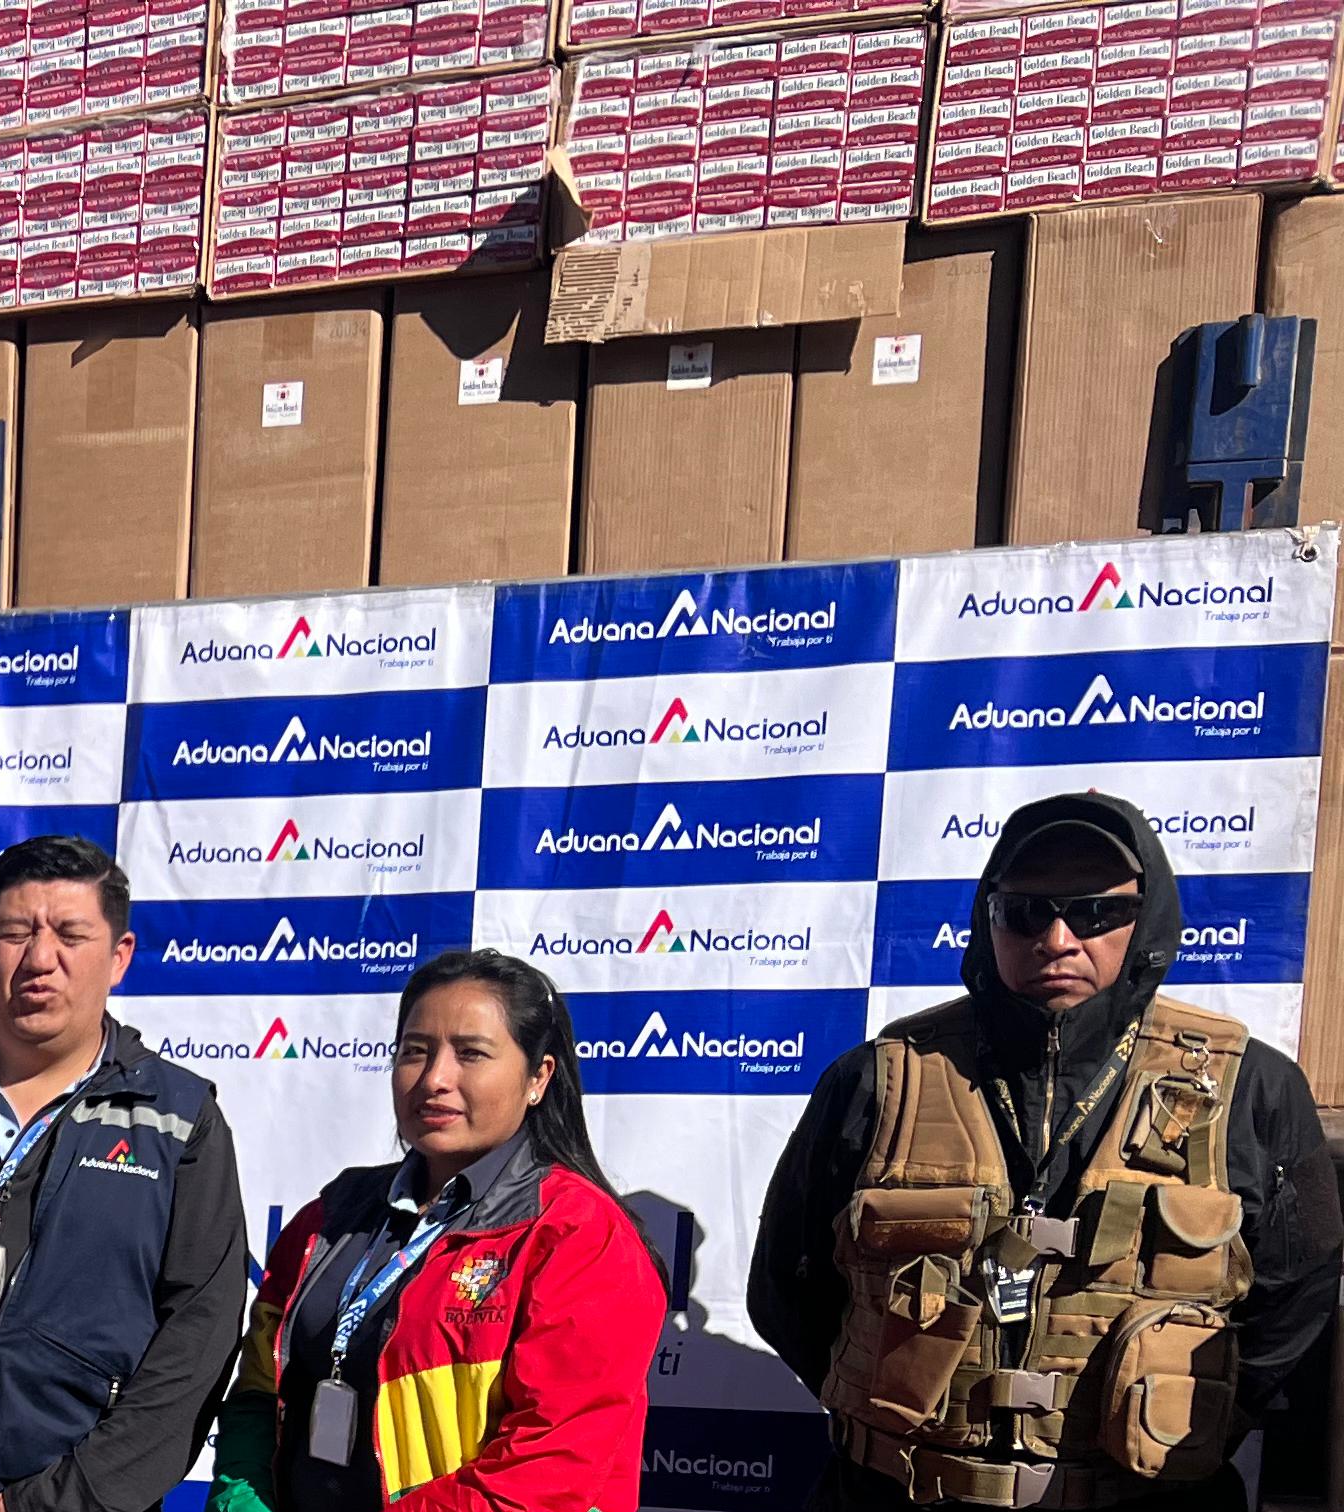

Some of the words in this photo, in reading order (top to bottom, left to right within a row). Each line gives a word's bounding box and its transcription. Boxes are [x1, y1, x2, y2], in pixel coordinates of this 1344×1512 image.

[855, 74, 886, 87] Golden
[892, 71, 920, 83] Beach
[934, 184, 967, 198] Golden
[970, 181, 1000, 194] Beach
[1010, 173, 1043, 186] Golden
[1047, 169, 1076, 183] Beach
[216, 262, 242, 274] Golden
[245, 259, 270, 271] Beach
[959, 591, 1073, 618] Aduana
[1139, 577, 1272, 608] Nacional
[549, 618, 653, 644] Aduana
[712, 602, 835, 634] Nacional
[181, 640, 272, 664] Aduana
[327, 628, 436, 656] Nacional
[949, 701, 1065, 730] Aduana
[1131, 692, 1263, 722] Nacional
[544, 725, 645, 749] Aduana
[705, 712, 826, 741] Nacional
[173, 741, 267, 766] Aduana
[319, 731, 430, 758] Nacional
[1148, 807, 1254, 833] acional
[169, 842, 261, 864] Aduana
[314, 835, 423, 860] Nacional
[536, 829, 639, 854] Aduana
[697, 818, 819, 849] Nacional
[162, 939, 257, 963] Aduana
[309, 934, 417, 960] Nacional
[530, 933, 631, 955] Aduana
[691, 927, 810, 952] Nacional
[160, 1037, 250, 1060] Aduana
[576, 1039, 625, 1059] ana
[682, 1032, 803, 1058] Nacional
[79, 1157, 117, 1171] Aduana
[118, 1164, 159, 1179] Nacional
[445, 1311, 504, 1324] BOLIVIA
[658, 1342, 683, 1375] ti
[654, 1450, 773, 1479] Nacional
